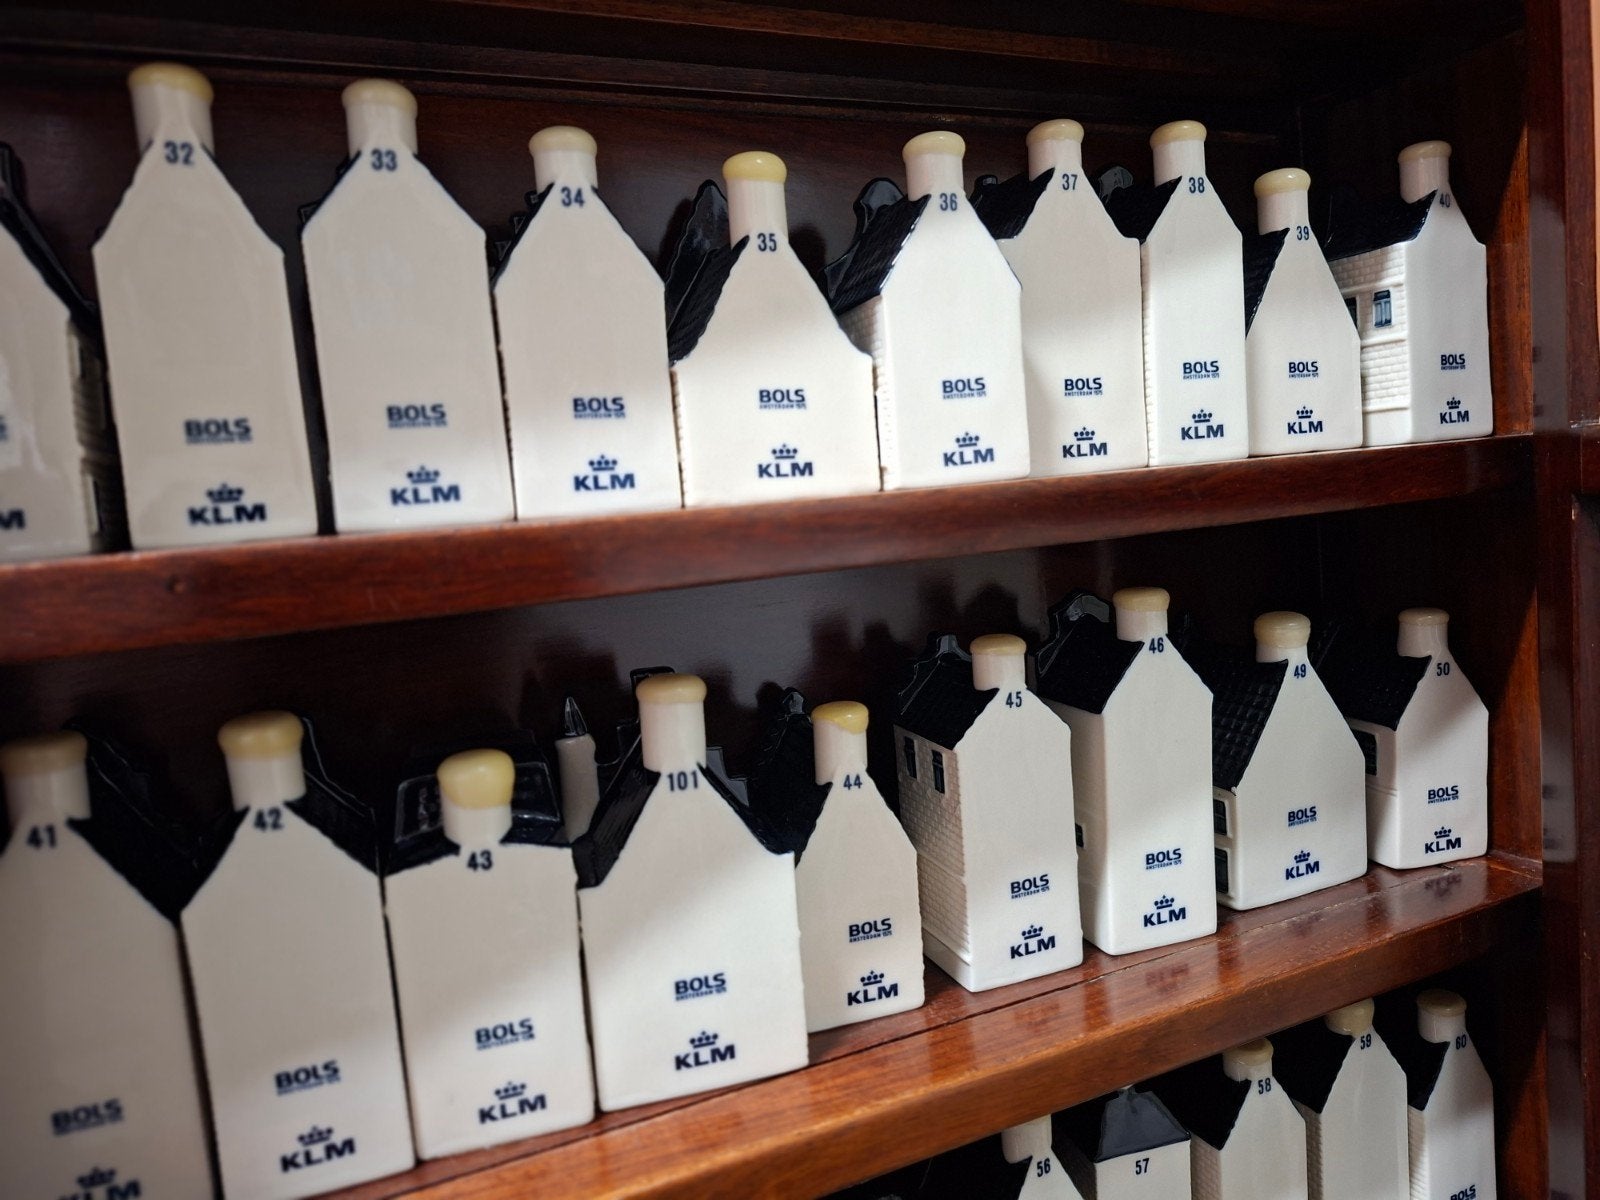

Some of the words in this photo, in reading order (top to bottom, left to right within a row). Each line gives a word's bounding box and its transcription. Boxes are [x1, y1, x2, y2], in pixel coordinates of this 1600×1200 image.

[164, 141, 193, 165] 32
[371, 148, 397, 172] 33
[1062, 174, 1077, 190] 37
[1189, 176, 1205, 194] 38
[561, 186, 585, 207] 34
[940, 193, 957, 211] 36
[1297, 225, 1310, 241] 39
[757, 233, 777, 252] 35
[1183, 361, 1219, 374] BOLS
[1289, 361, 1318, 373] BOLS
[1441, 354, 1465, 365] BOLS
[942, 378, 985, 394] BOLS
[1065, 377, 1102, 391] BOLS
[573, 397, 625, 412] BOLS
[759, 389, 805, 403] BOLS
[387, 404, 446, 421] BOLS
[1440, 411, 1469, 424] KLM
[185, 418, 251, 438] BOLS
[1181, 425, 1224, 440] KLM
[1288, 421, 1323, 434] KLM
[943, 449, 994, 466] KLM
[1063, 443, 1107, 458] KLM
[758, 462, 813, 478] KLM
[574, 473, 635, 491] KLM
[391, 485, 460, 505] KLM
[188, 503, 266, 524] KLM
[1149, 637, 1164, 654] 46
[1294, 664, 1306, 679] 49
[1437, 662, 1450, 676] 50
[1006, 691, 1022, 708] 45
[667, 771, 699, 792] 101
[843, 774, 862, 790] 44
[1428, 785, 1458, 800] BOLS
[254, 806, 284, 832] 42
[1288, 806, 1316, 822] BOLS
[27, 825, 57, 850] 41
[1425, 837, 1461, 853] KLM
[467, 850, 493, 871] 43
[1146, 848, 1182, 865] BOLS
[1286, 862, 1319, 880] KLM
[1011, 874, 1049, 894] BOLS
[1144, 908, 1186, 927] KLM
[849, 918, 892, 937] BOLS
[1011, 936, 1055, 959] KLM
[675, 973, 726, 995] BOLS
[847, 983, 898, 1006] KLM
[476, 1018, 533, 1044] BOLS
[1361, 1033, 1371, 1050] 59
[1456, 1034, 1467, 1050] 60
[675, 1045, 735, 1070] KLM
[275, 1061, 339, 1090] BOLS
[1258, 1077, 1271, 1094] 58
[479, 1095, 546, 1124] KLM
[280, 1138, 355, 1173] KLM
[1037, 1158, 1050, 1177] 56
[1136, 1158, 1149, 1175] 57
